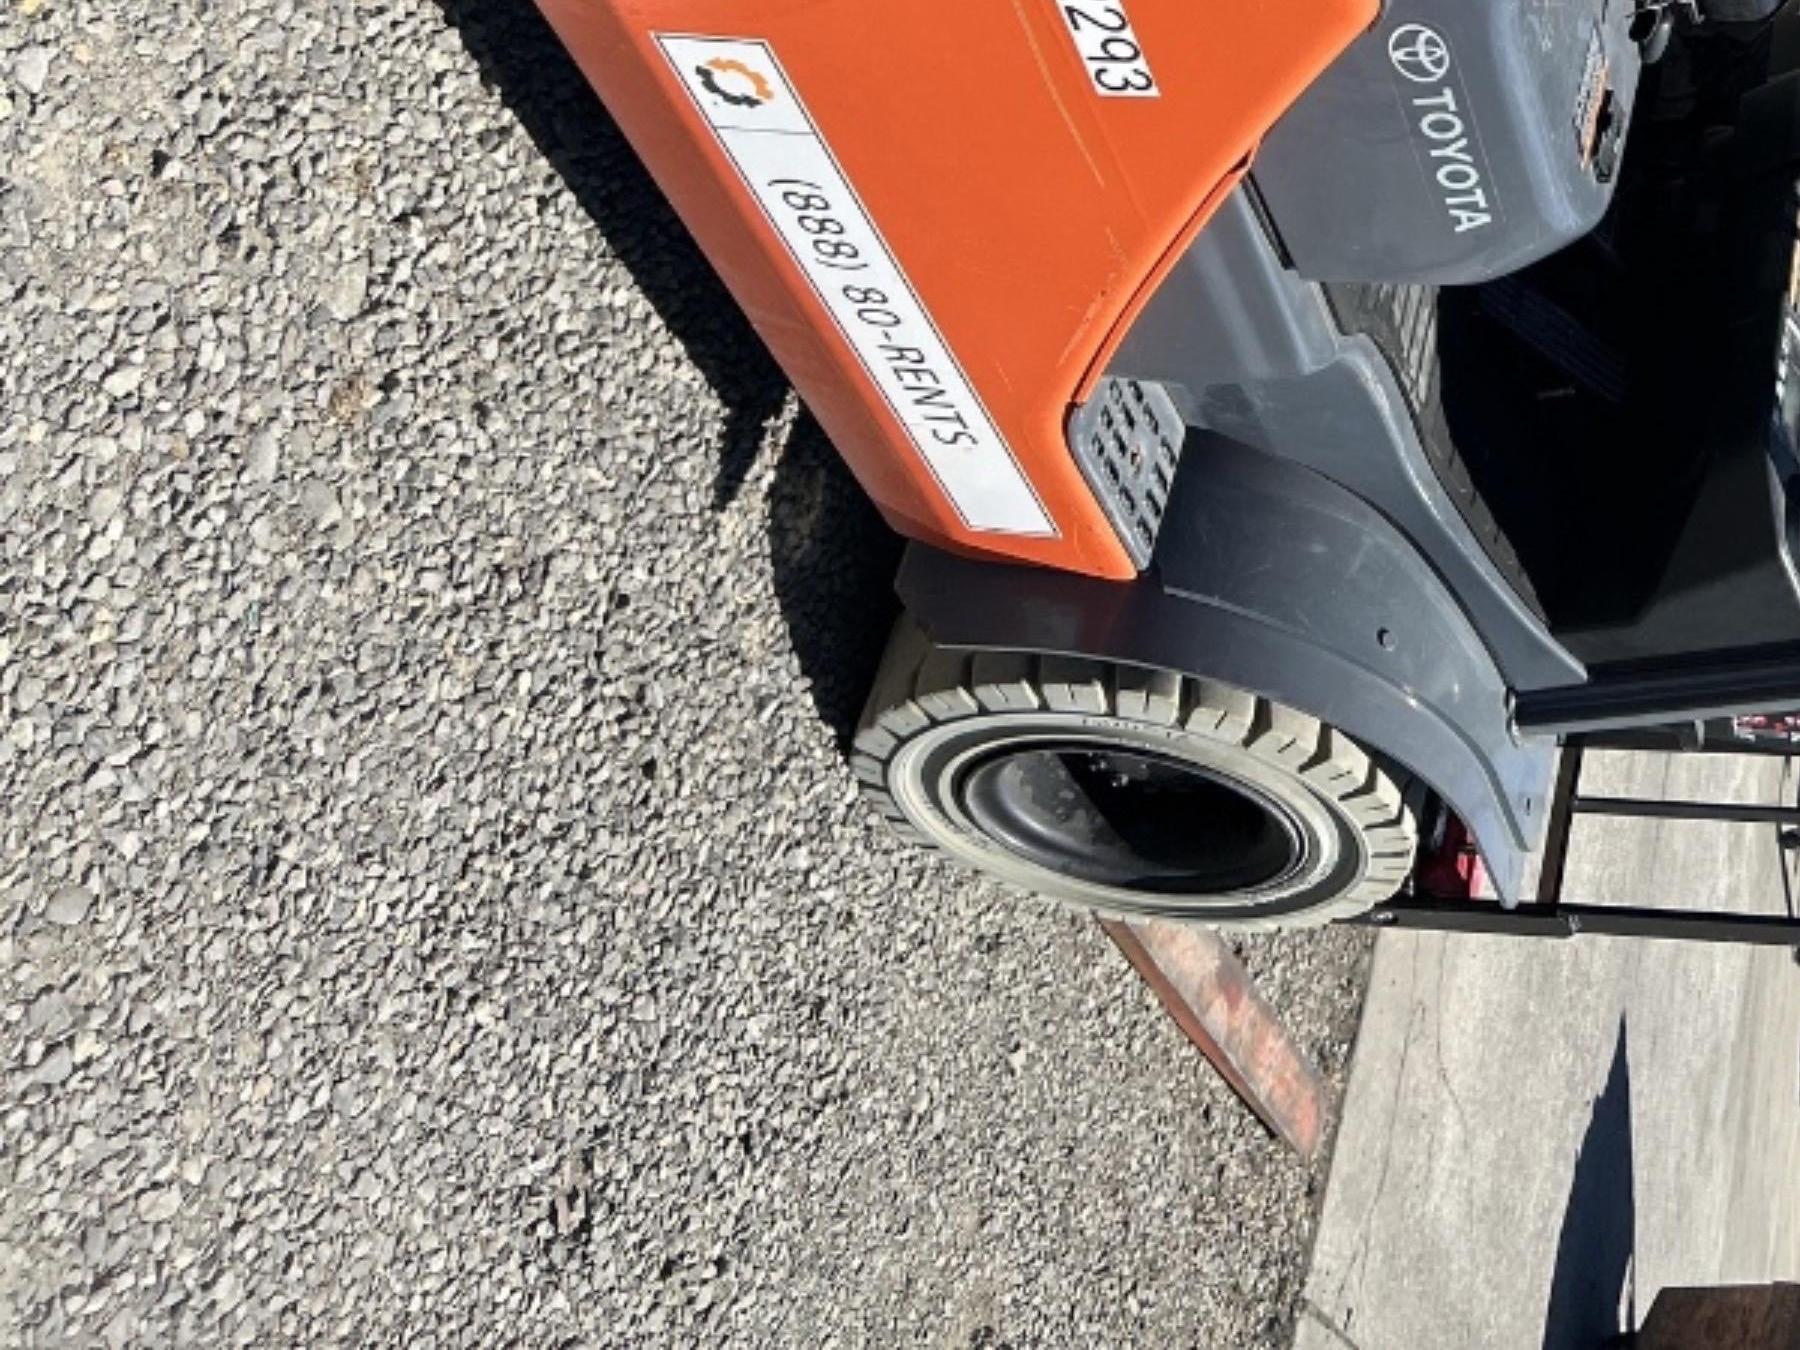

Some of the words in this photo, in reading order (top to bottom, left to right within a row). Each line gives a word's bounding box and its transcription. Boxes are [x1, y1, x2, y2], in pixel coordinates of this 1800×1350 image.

[1412, 86, 1492, 232] TOYOTA
[767, 178, 869, 272] (888)
[841, 284, 979, 446] 80-RENTS
